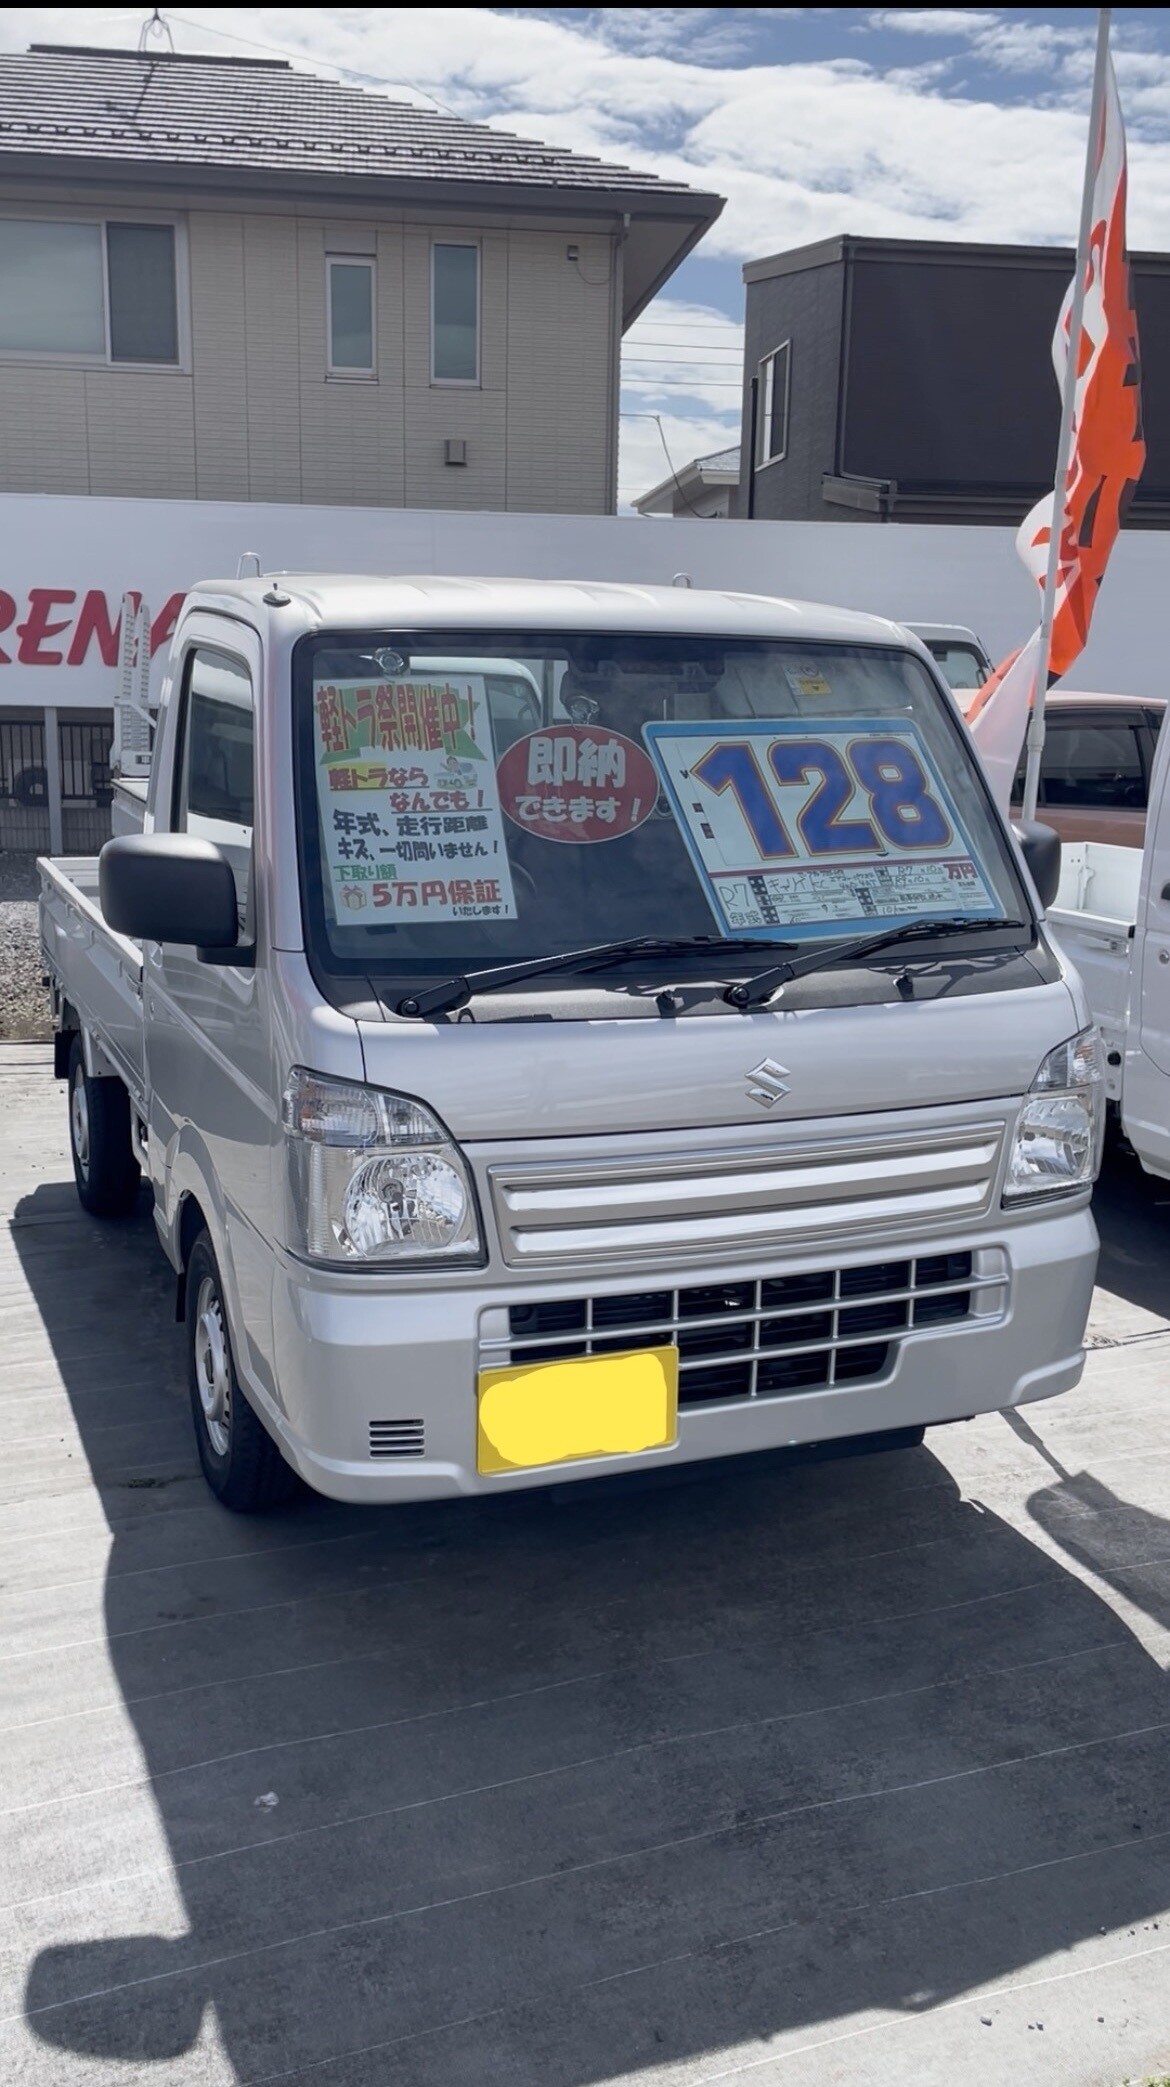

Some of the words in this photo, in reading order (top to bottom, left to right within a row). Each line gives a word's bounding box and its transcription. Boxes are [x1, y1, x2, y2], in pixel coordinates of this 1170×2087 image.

[0, 588, 188, 667] EN
[527, 736, 627, 788] 即納
[328, 767, 429, 789] 軽トラなら
[389, 790, 484, 812] なんでも！
[515, 796, 641, 823] できます！
[689, 737, 954, 860] 128
[333, 809, 489, 836] 年式、走行距離
[333, 864, 398, 881] 下取り額
[943, 863, 979, 880] 万円
[372, 880, 502, 907] 5万円保証
[719, 883, 750, 911] R7
